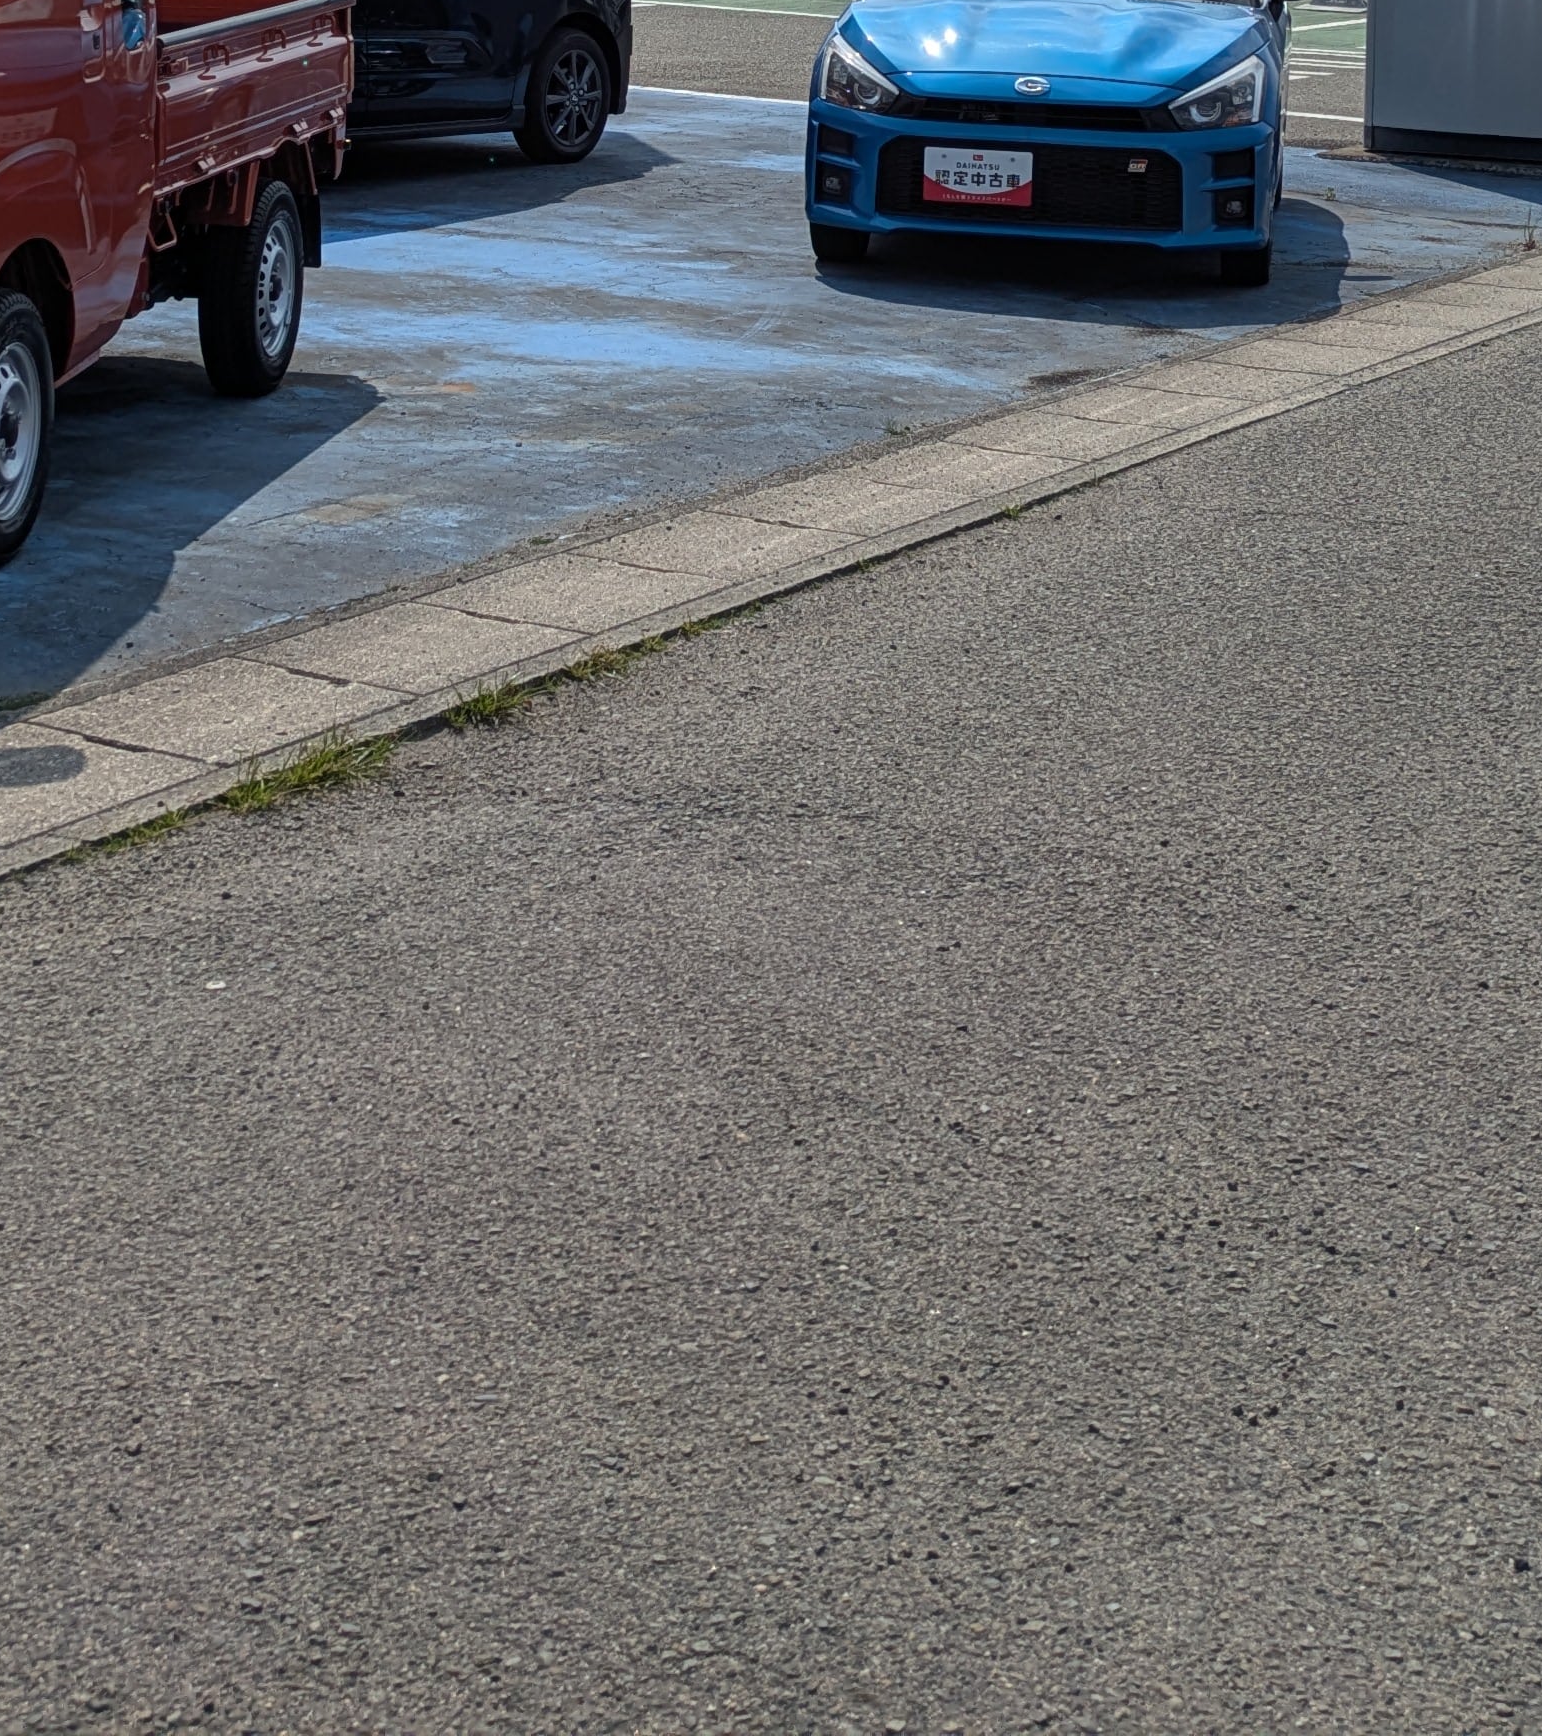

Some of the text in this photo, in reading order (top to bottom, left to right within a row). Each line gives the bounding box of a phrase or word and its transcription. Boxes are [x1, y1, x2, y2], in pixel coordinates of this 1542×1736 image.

[956, 161, 1000, 171] DAIHATSU
[934, 169, 1021, 190] 認定中古車
